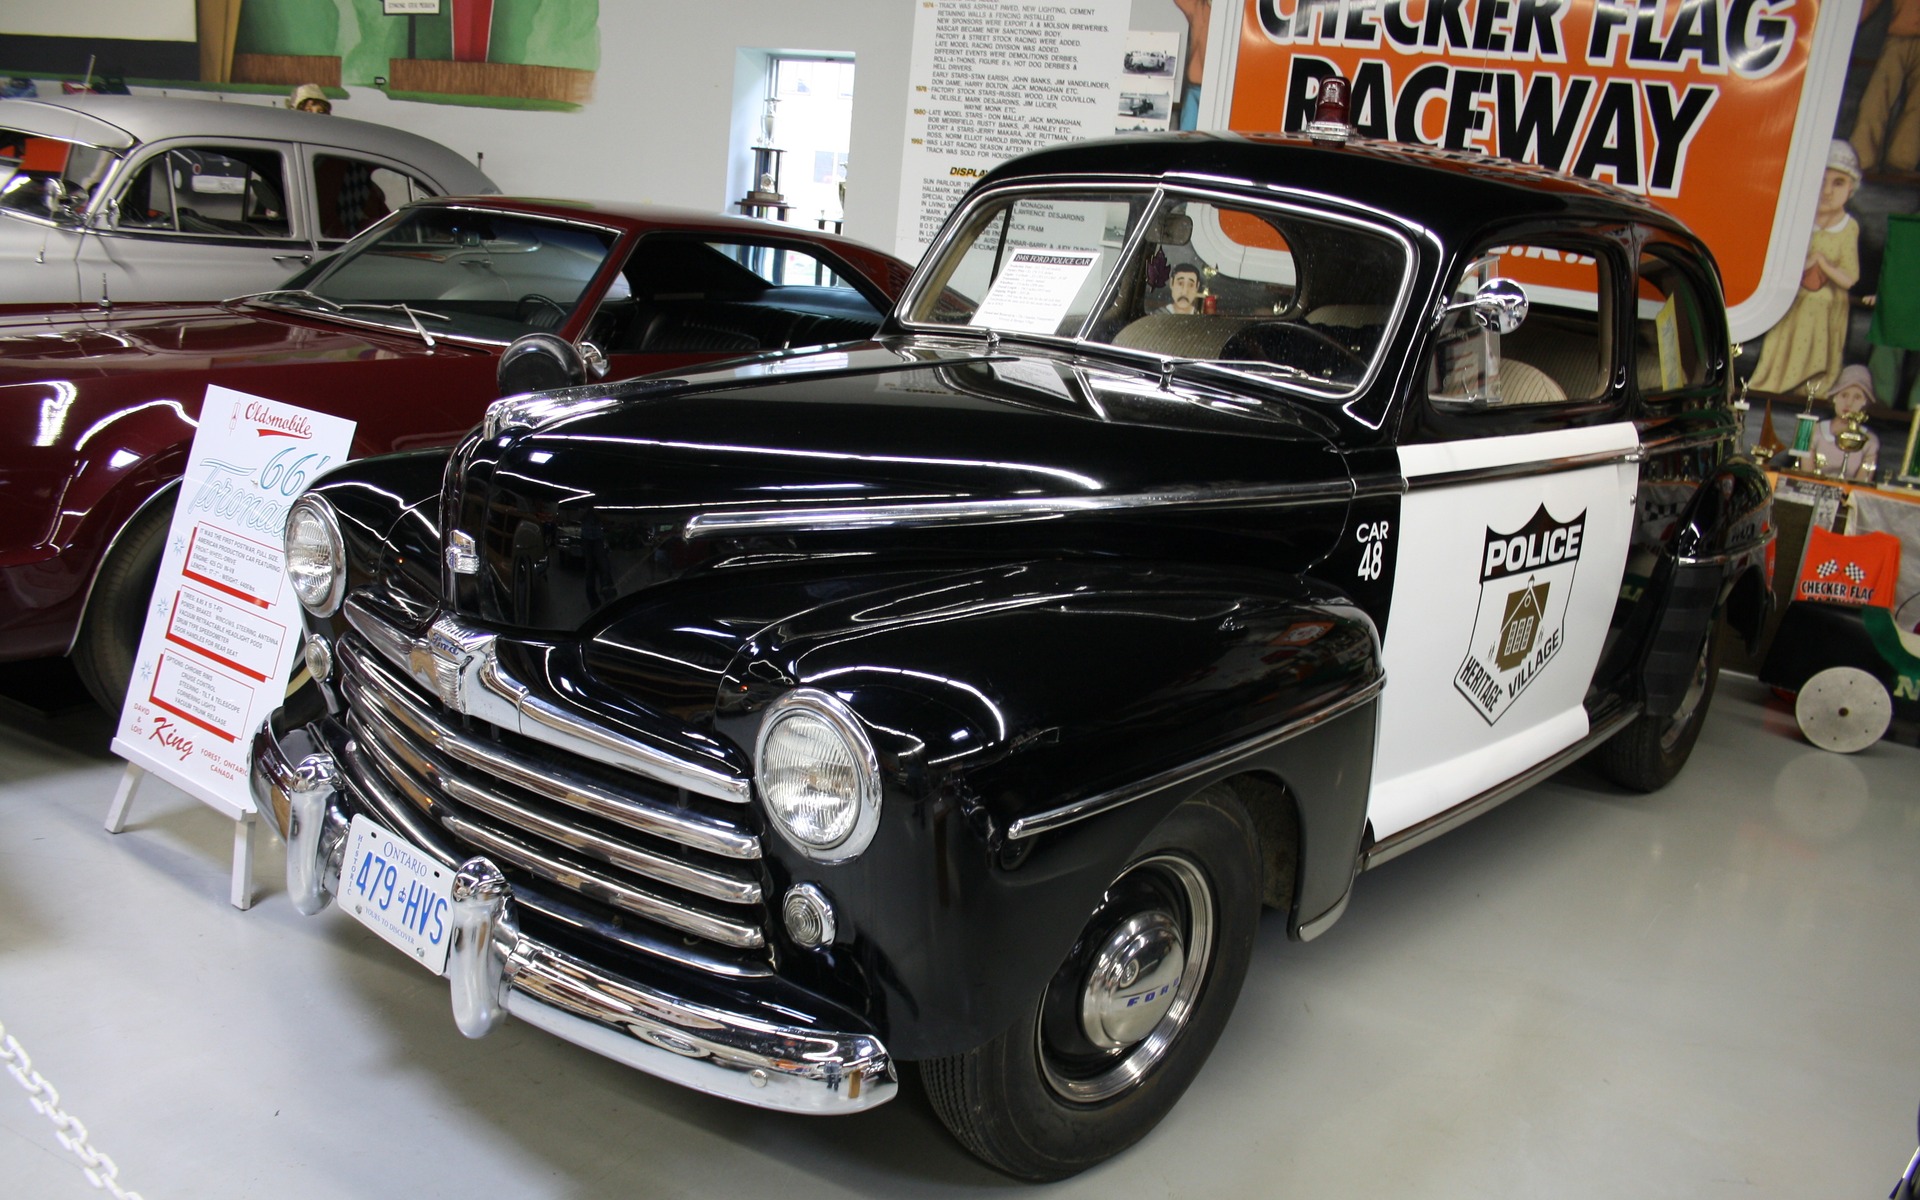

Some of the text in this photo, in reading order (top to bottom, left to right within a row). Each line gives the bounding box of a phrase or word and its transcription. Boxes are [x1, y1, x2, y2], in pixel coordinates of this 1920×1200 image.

[1258, 0, 1792, 75] CHECKER FLAG
[1283, 55, 1717, 194] RACEWAY
[245, 401, 312, 438] Oldsmobile
[188, 457, 292, 541] Torona
[1356, 520, 1389, 543] CAR
[1484, 524, 1582, 577] POLICE
[1357, 540, 1383, 582] 48
[1801, 580, 1847, 597] CHECKER
[1459, 628, 1560, 714] HERITAGE VILLAGE
[133, 703, 150, 715] DAVID
[131, 724, 142, 735] LOIS
[149, 717, 194, 761] King
[210, 763, 235, 781] CANADA
[383, 841, 428, 878] ONTARIO
[356, 851, 449, 945] 479 HVS
[365, 906, 381, 923] YOURS
[389, 921, 415, 946] DISCOVER
[1127, 976, 1180, 1007] FORD
